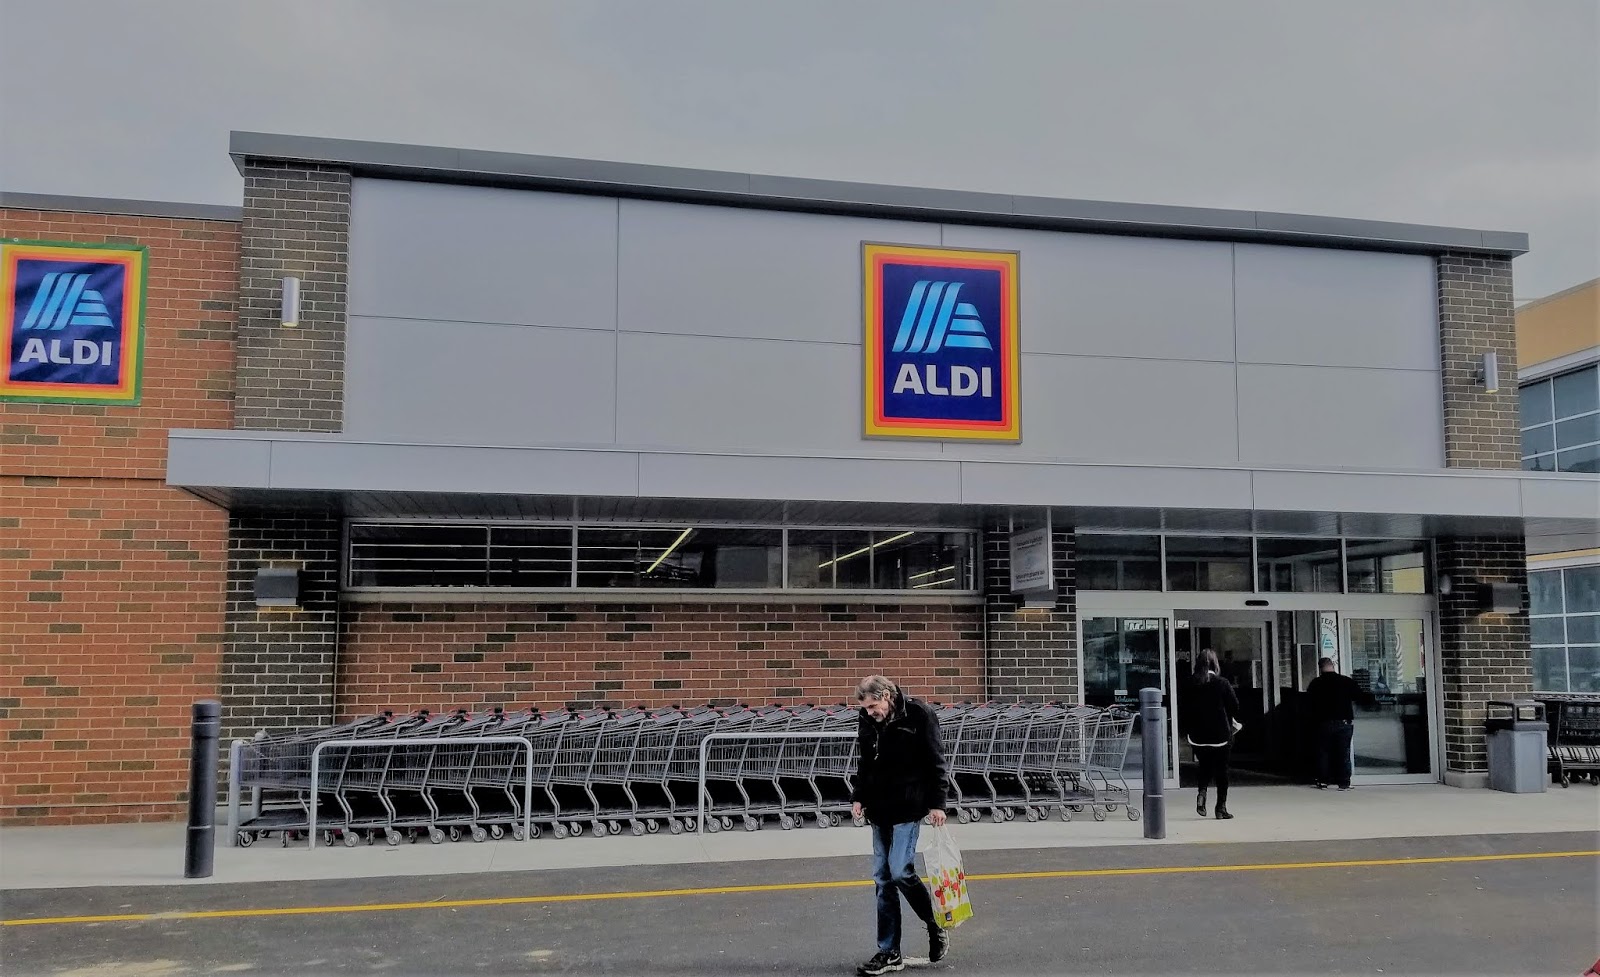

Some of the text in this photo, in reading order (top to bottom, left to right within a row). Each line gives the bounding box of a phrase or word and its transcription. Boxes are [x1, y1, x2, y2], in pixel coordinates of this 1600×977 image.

[19, 338, 112, 366] ALDI
[892, 363, 992, 397] ALDI
[1321, 617, 1333, 626] TER
